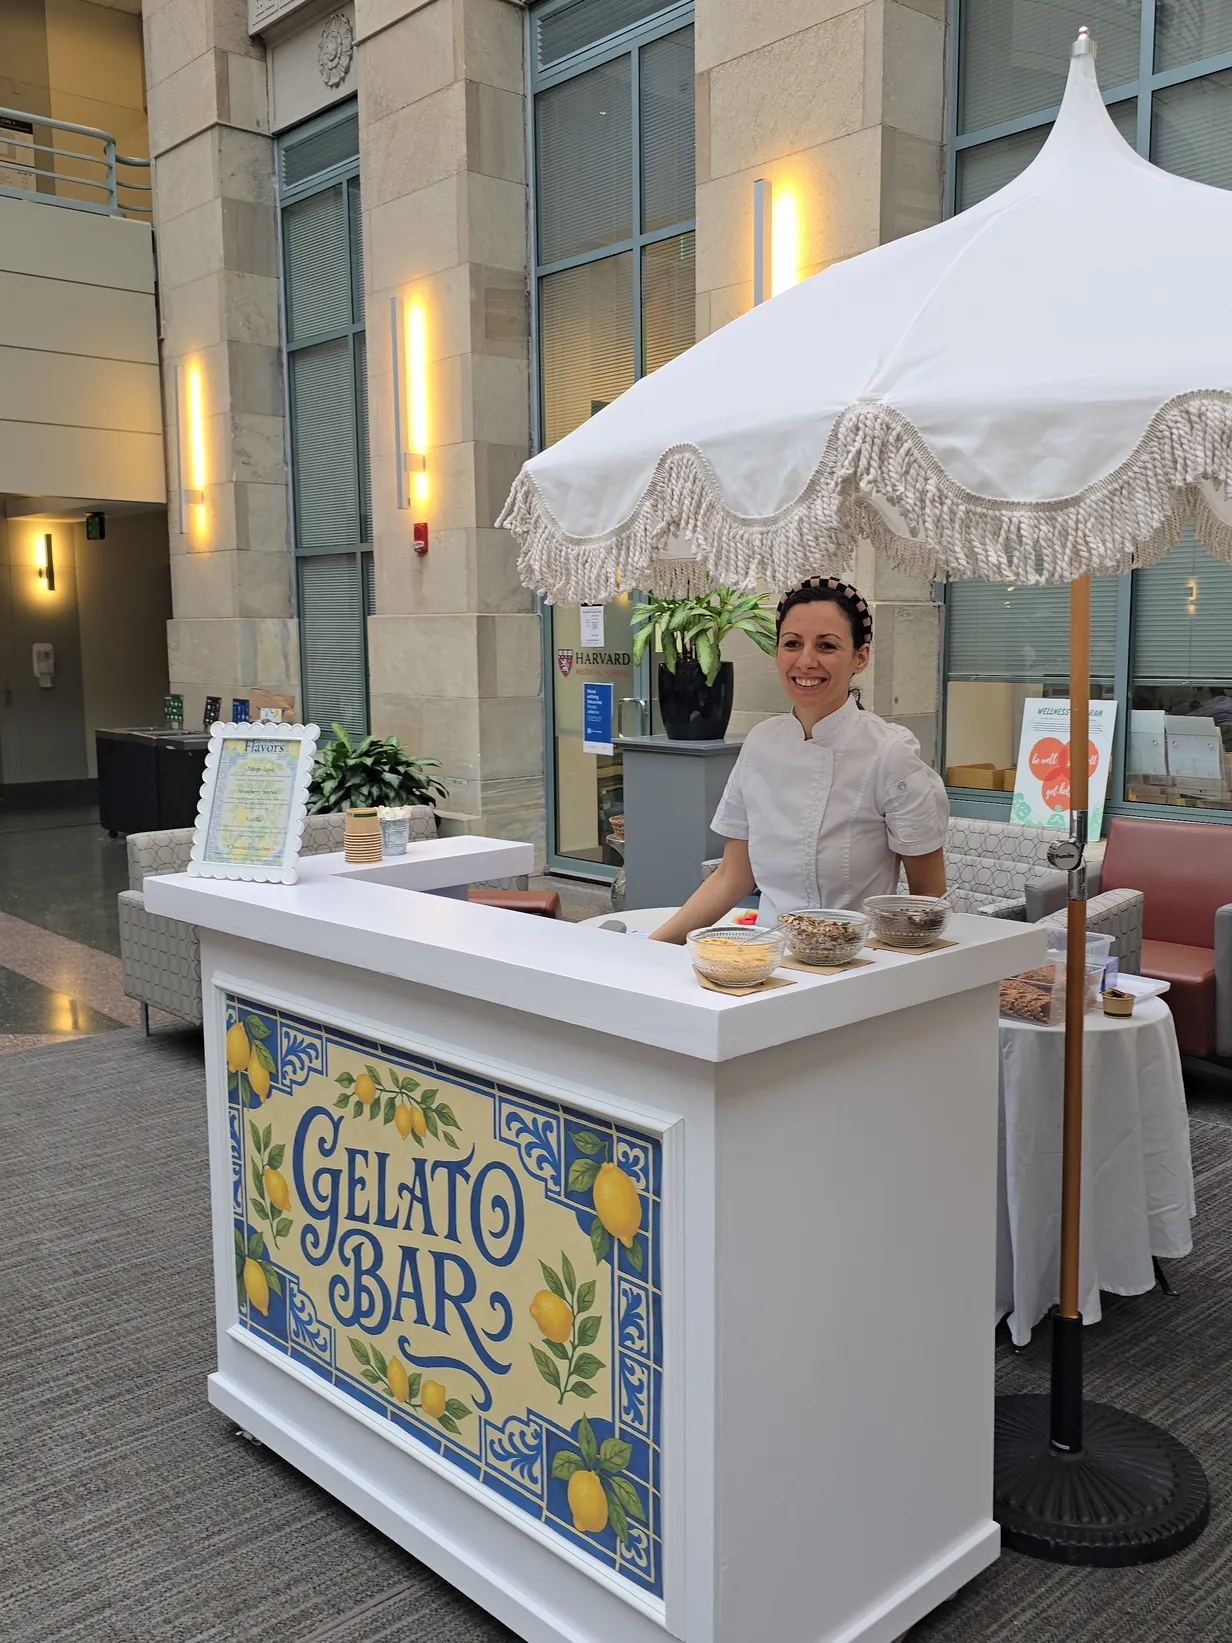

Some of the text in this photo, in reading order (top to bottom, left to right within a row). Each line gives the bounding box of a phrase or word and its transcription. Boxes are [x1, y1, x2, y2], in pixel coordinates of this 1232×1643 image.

[575, 652, 631, 665] HARVARD
[1038, 707, 1070, 716] WELLNESS
[244, 739, 285, 752] Flavors
[1041, 752, 1058, 765] well
[1045, 785, 1059, 800] get
[293, 1106, 525, 1268] GELATO
[329, 1228, 513, 1375] BAR
